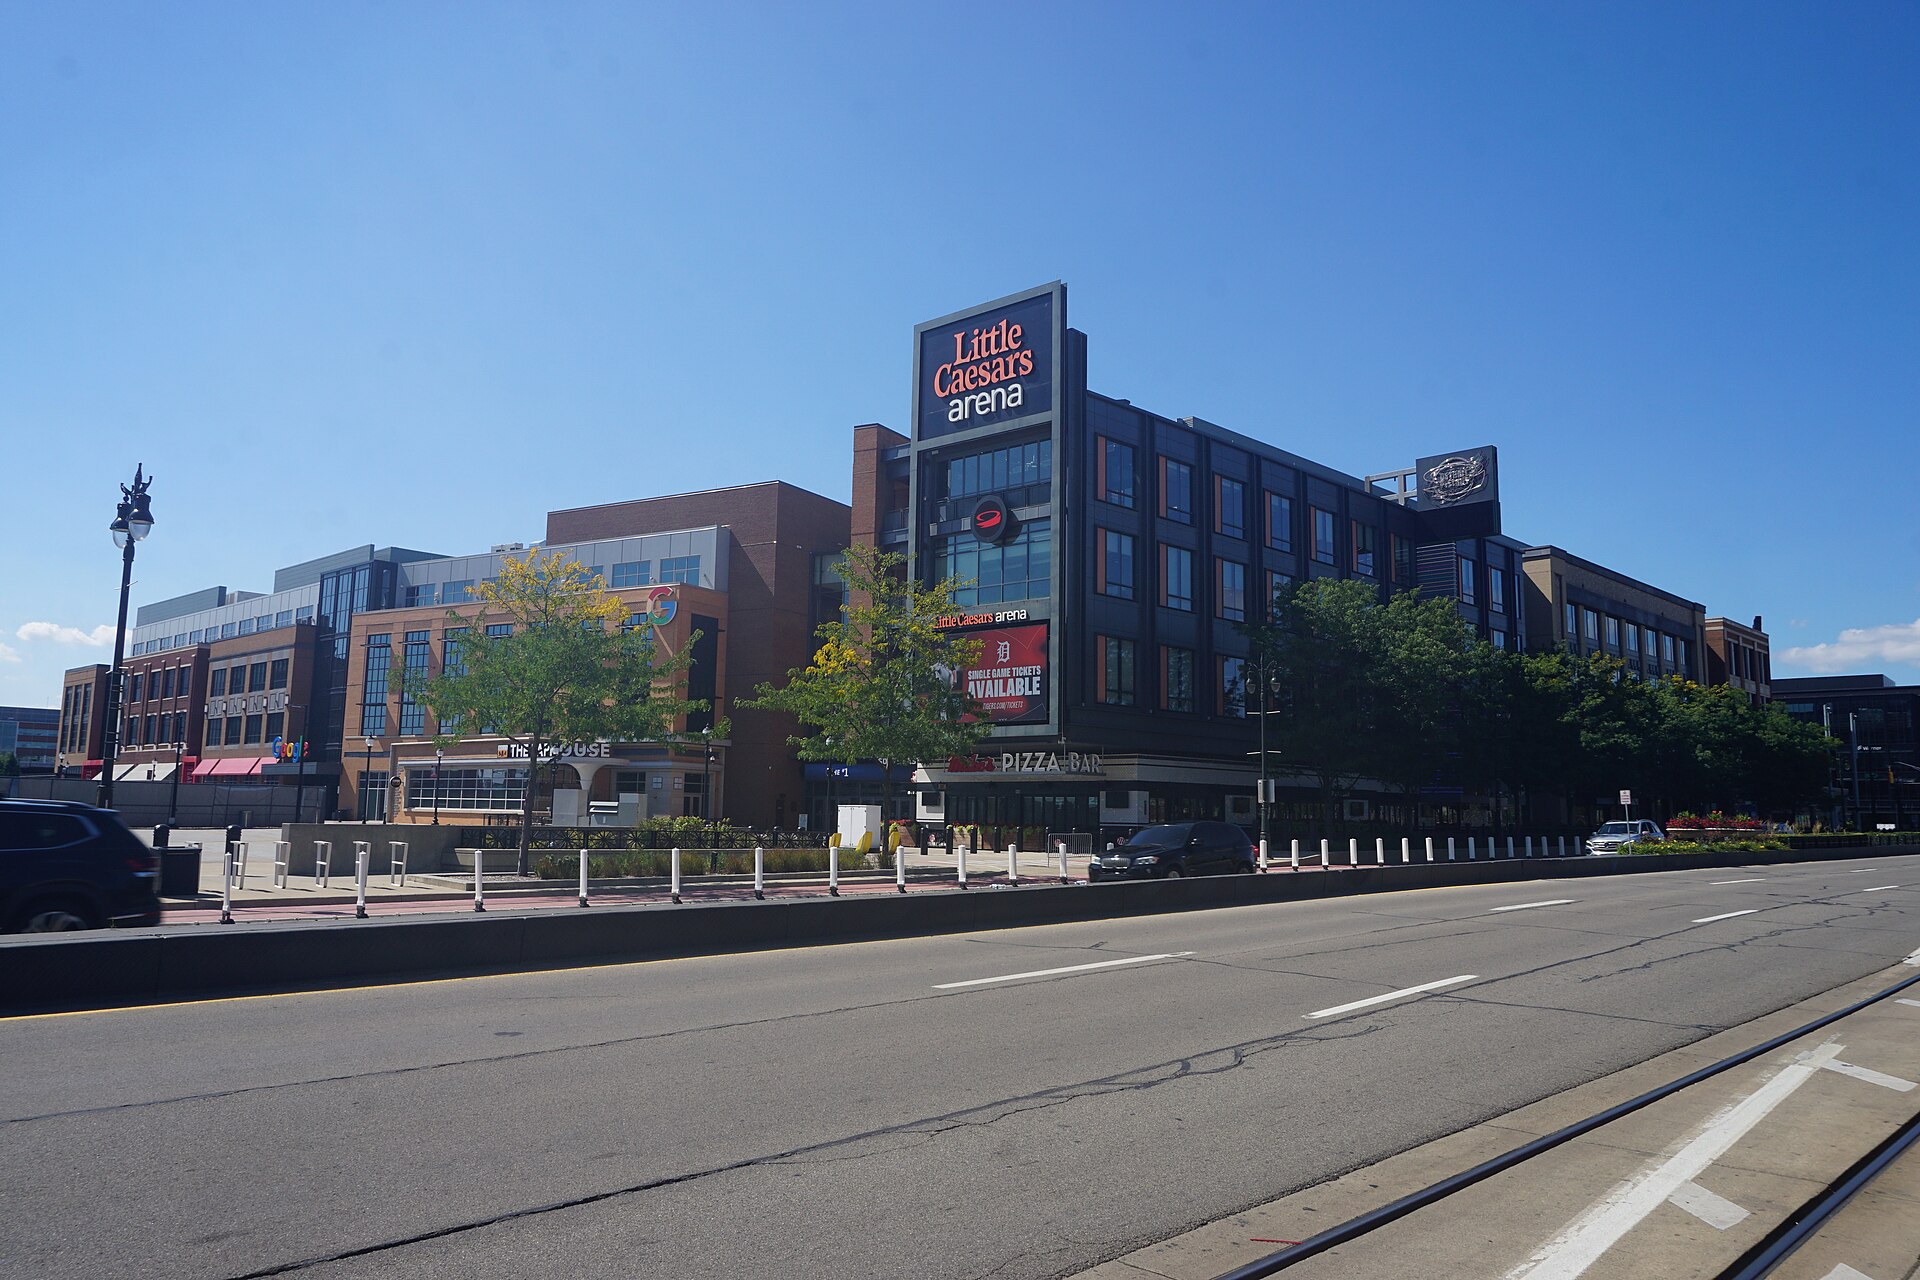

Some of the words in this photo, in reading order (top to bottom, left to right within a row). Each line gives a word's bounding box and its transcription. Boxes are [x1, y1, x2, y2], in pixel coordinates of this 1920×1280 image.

[953, 318, 1022, 366] Little
[934, 349, 1034, 398] Caesars
[948, 382, 1023, 423] arena
[957, 612, 994, 626] Caesars
[995, 609, 1027, 622] arena
[967, 669, 991, 681] SINGLE
[991, 667, 1011, 679] GAME
[1012, 664, 1042, 677] TICKETS
[967, 676, 1041, 699] AVAILABLE
[510, 743, 529, 758] THE
[1001, 752, 1061, 773] PIZZA
[1068, 751, 1101, 774] BAR
